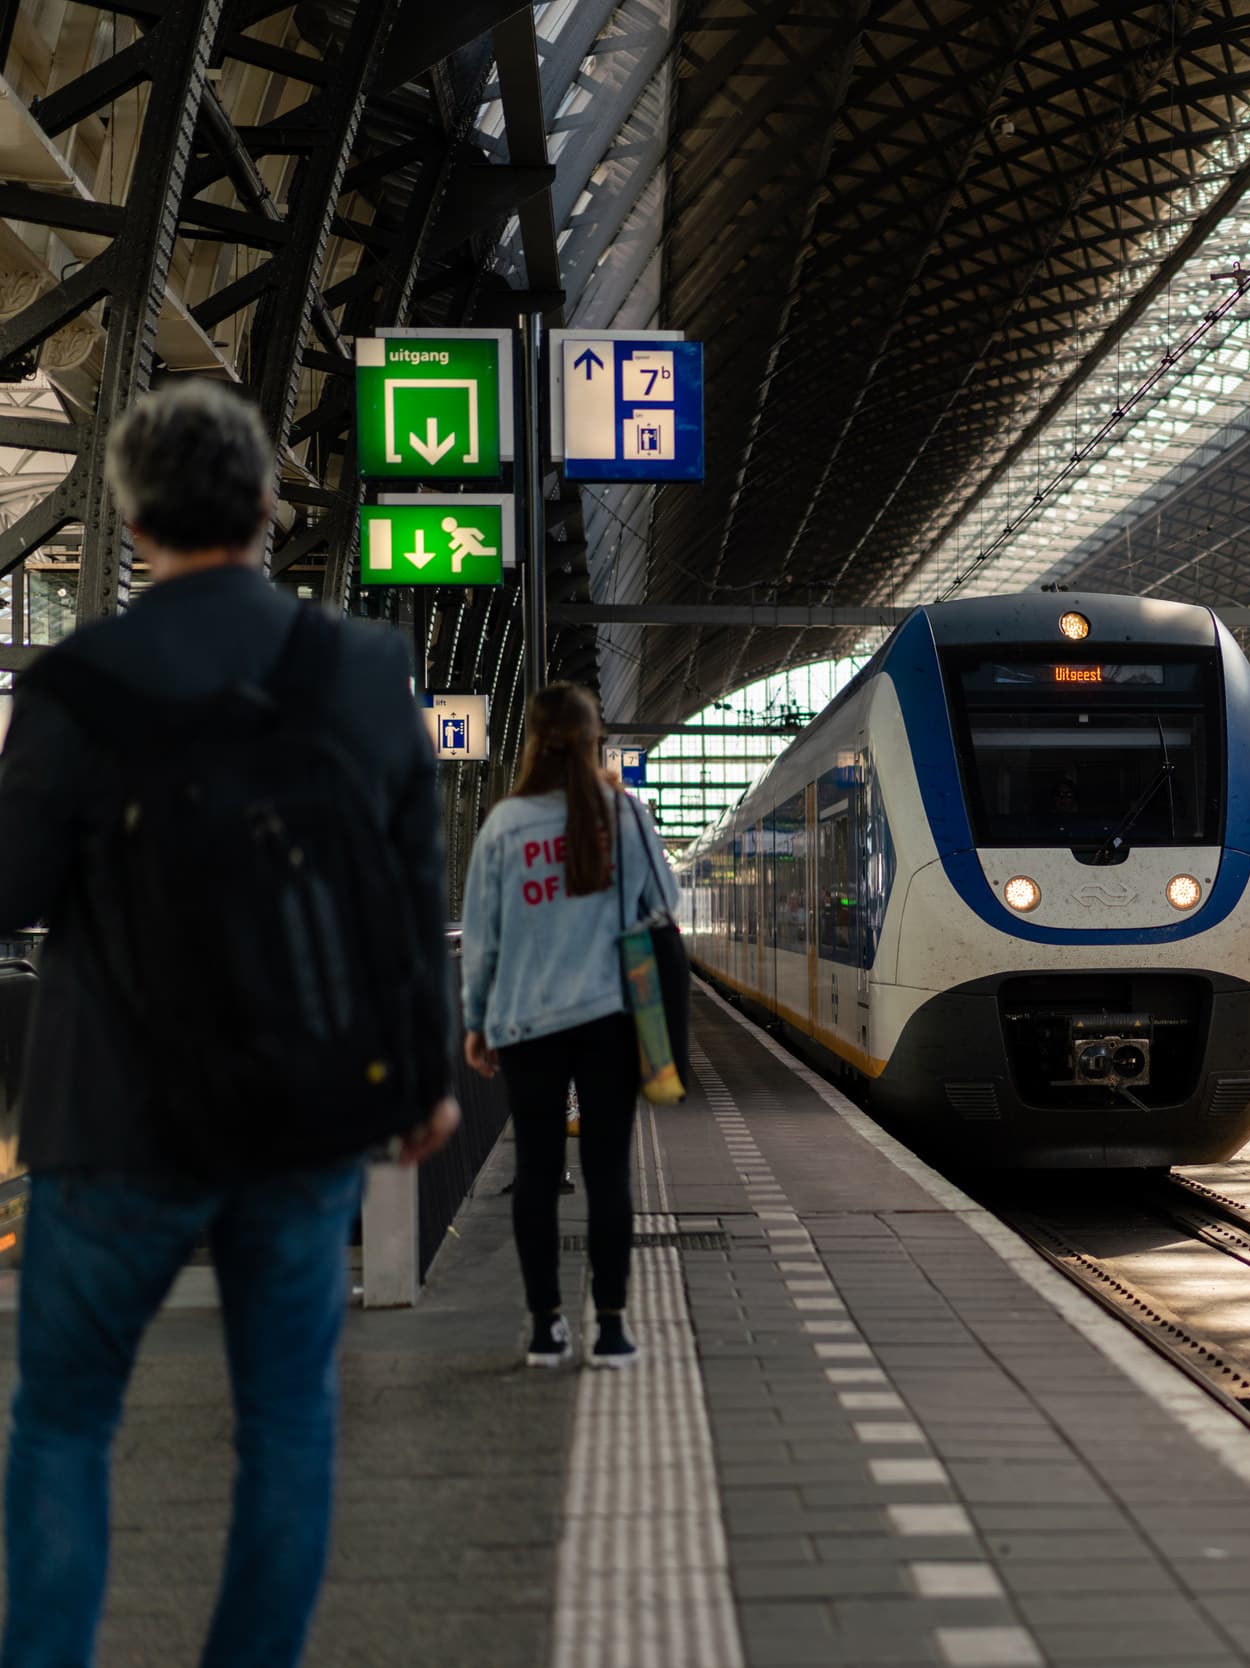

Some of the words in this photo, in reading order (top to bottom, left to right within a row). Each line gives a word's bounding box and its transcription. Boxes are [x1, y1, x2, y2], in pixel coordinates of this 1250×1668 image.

[389, 348, 449, 365] uitgang
[1055, 666, 1102, 681] Uitgeest
[523, 875, 560, 906] OF
